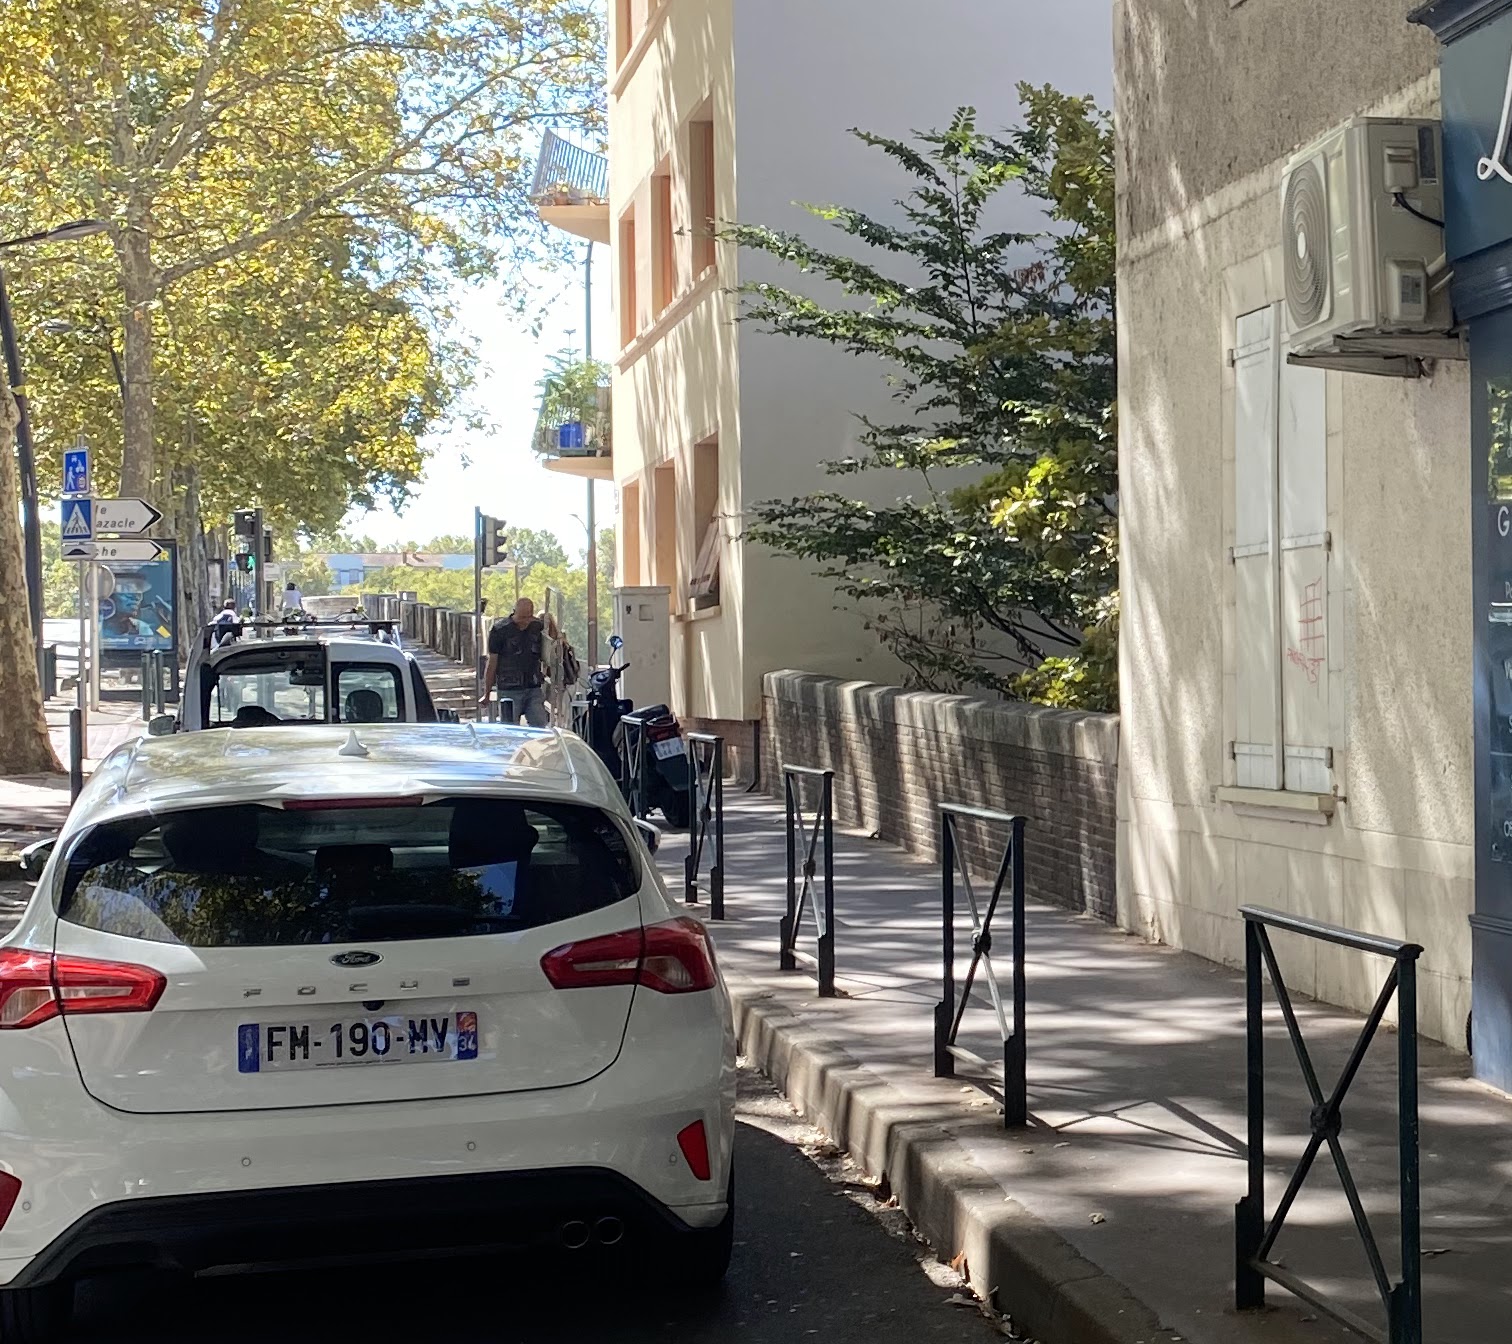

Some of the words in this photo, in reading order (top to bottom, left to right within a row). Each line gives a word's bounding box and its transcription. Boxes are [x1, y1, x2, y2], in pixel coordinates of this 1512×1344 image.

[96, 518, 136, 528] azacle
[243, 976, 471, 999] FOCUS
[266, 1017, 449, 1062] FM-190-MV
[458, 1033, 477, 1053] 34
